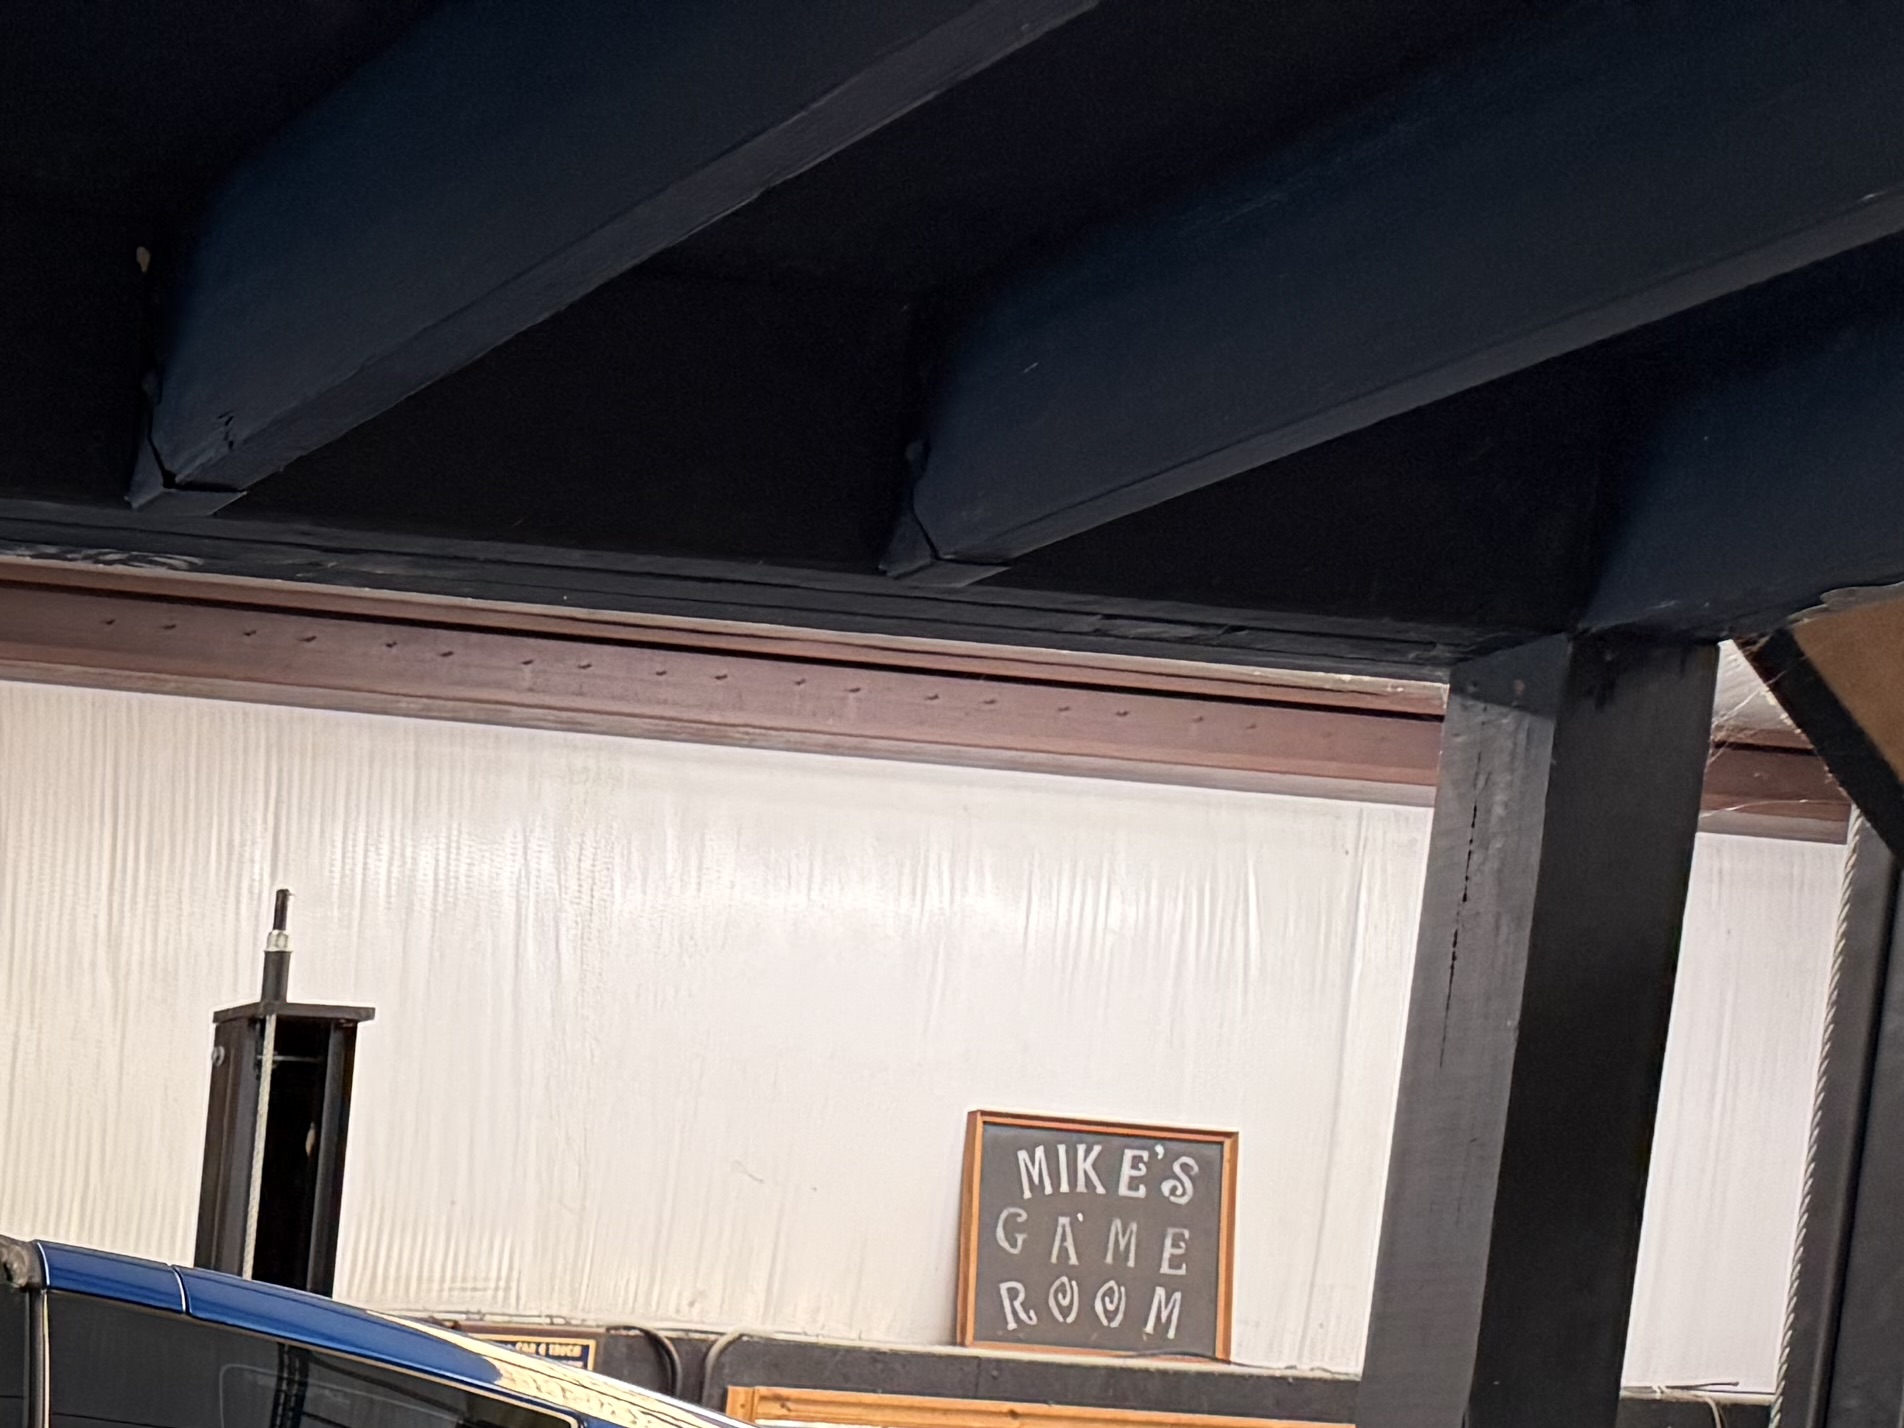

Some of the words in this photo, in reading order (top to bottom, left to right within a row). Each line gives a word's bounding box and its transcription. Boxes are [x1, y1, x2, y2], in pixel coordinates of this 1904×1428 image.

[1017, 1143, 1200, 1206] MIKE'S
[996, 1207, 1190, 1276] GAME
[999, 1275, 1182, 1340] ROOM
